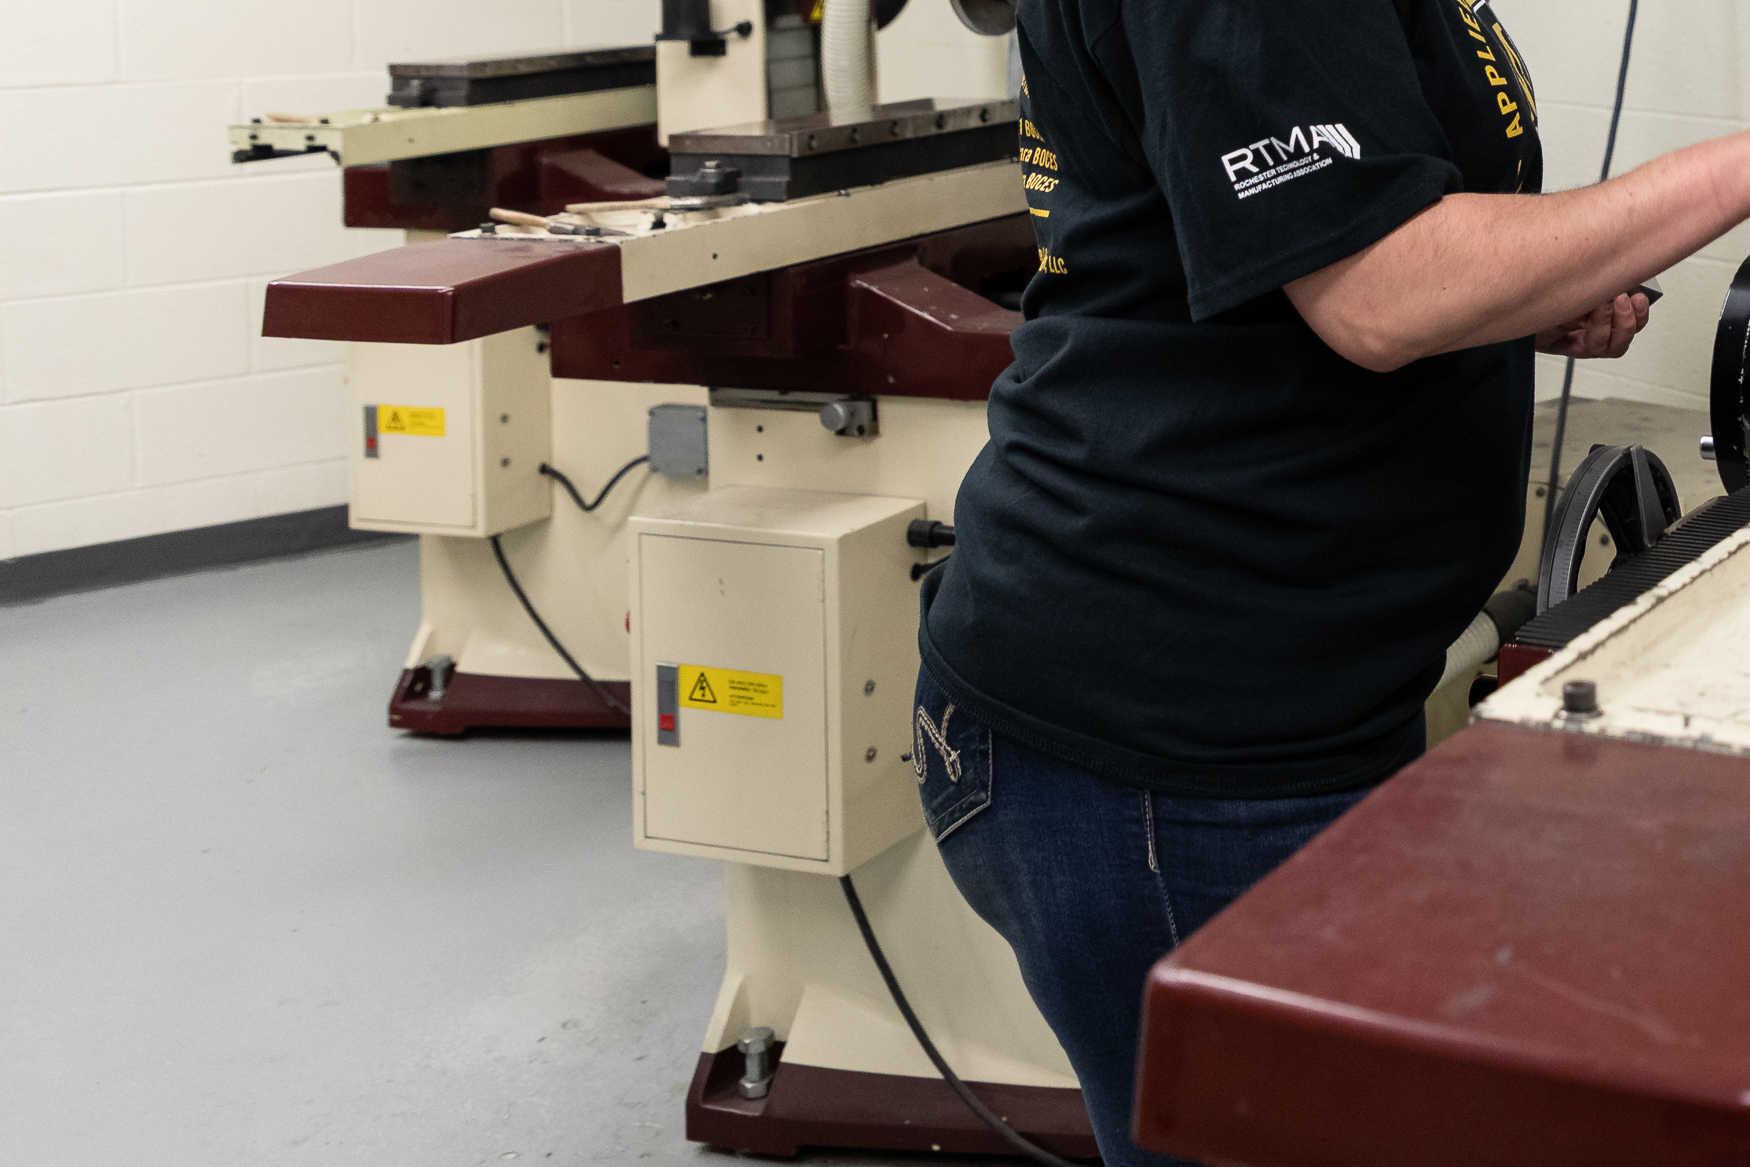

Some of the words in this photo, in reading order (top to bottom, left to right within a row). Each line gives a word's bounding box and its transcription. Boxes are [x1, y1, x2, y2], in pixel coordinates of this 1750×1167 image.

[1032, 146, 1058, 171] BOCES
[1221, 124, 1360, 183] RTMA
[1026, 172, 1059, 193] BOCES
[1234, 168, 1276, 191] ROCHESTER
[1276, 155, 1313, 174] TECHNOLOGY
[1237, 172, 1294, 199] MANUFACTURING
[1049, 255, 1068, 274] LLC
